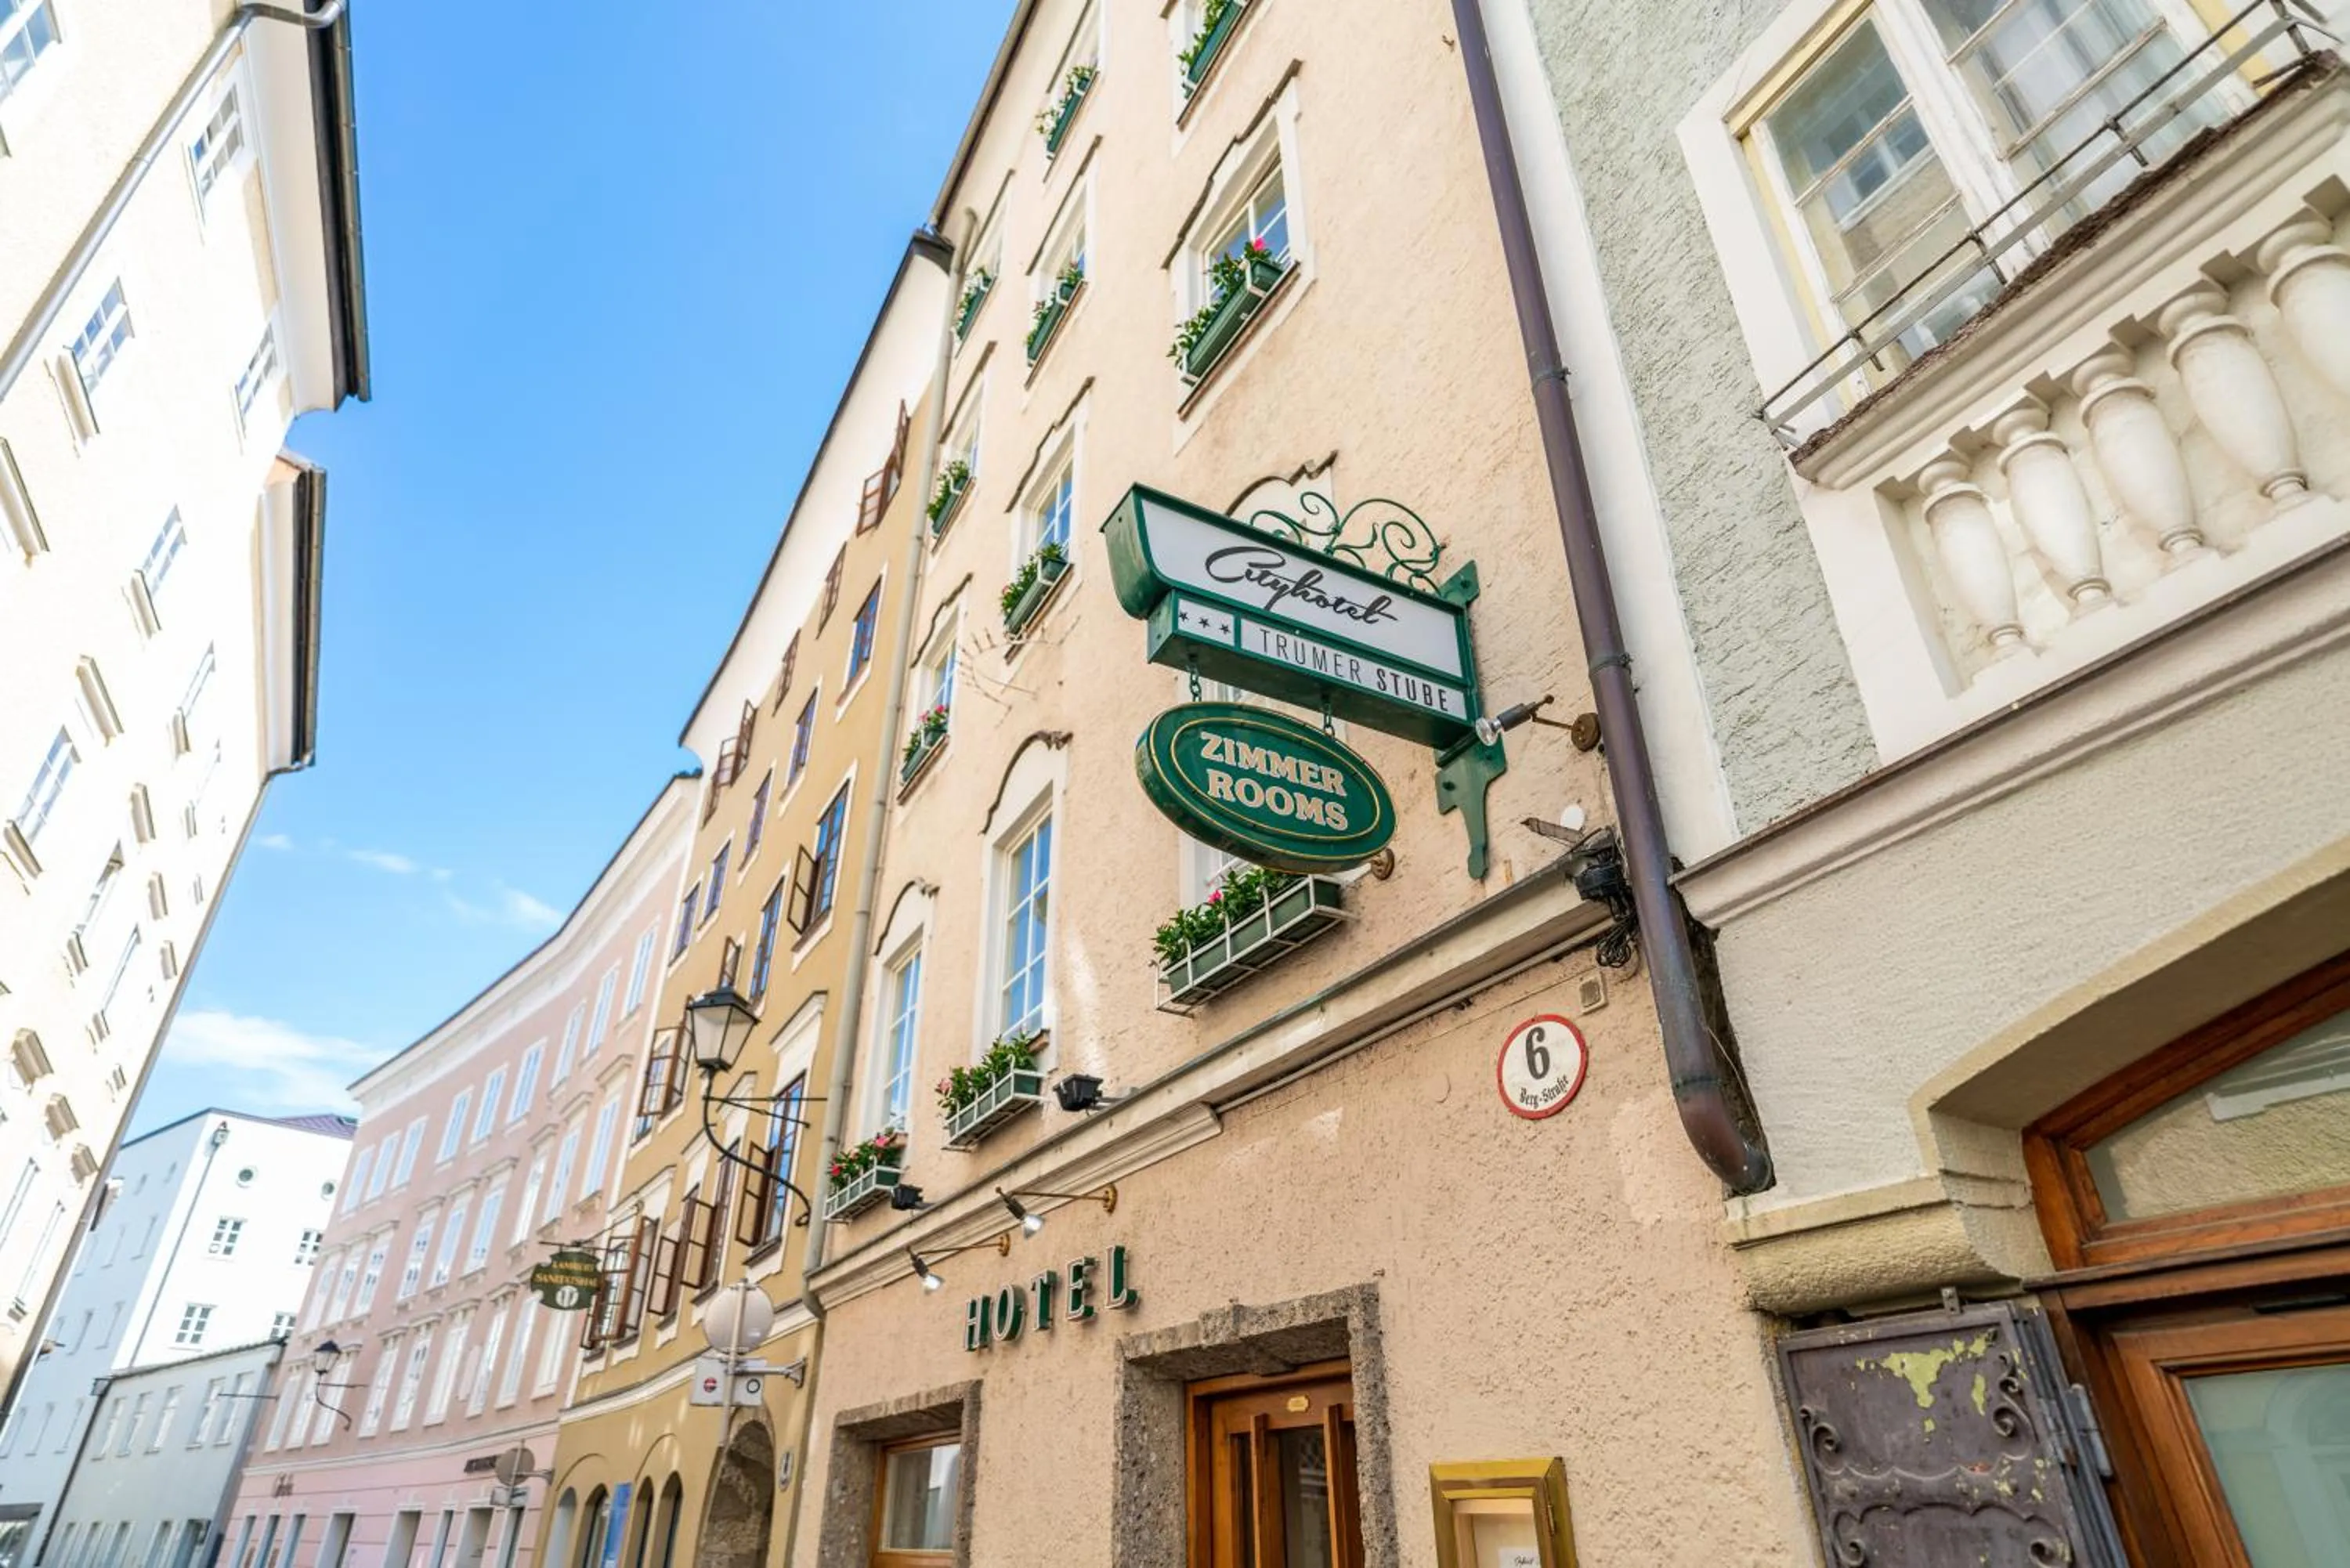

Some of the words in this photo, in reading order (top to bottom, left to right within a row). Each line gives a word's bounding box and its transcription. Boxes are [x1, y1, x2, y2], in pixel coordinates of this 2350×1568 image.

[1206, 546, 1398, 624] Cityhotel
[1260, 629, 1362, 684] TRUMER
[1376, 668, 1448, 712] STUBE
[1200, 731, 1347, 797] ZIMMER
[1206, 768, 1348, 831] ROOMS
[1525, 1026, 1550, 1080] 6
[964, 1245, 1140, 1352] HOTEL
